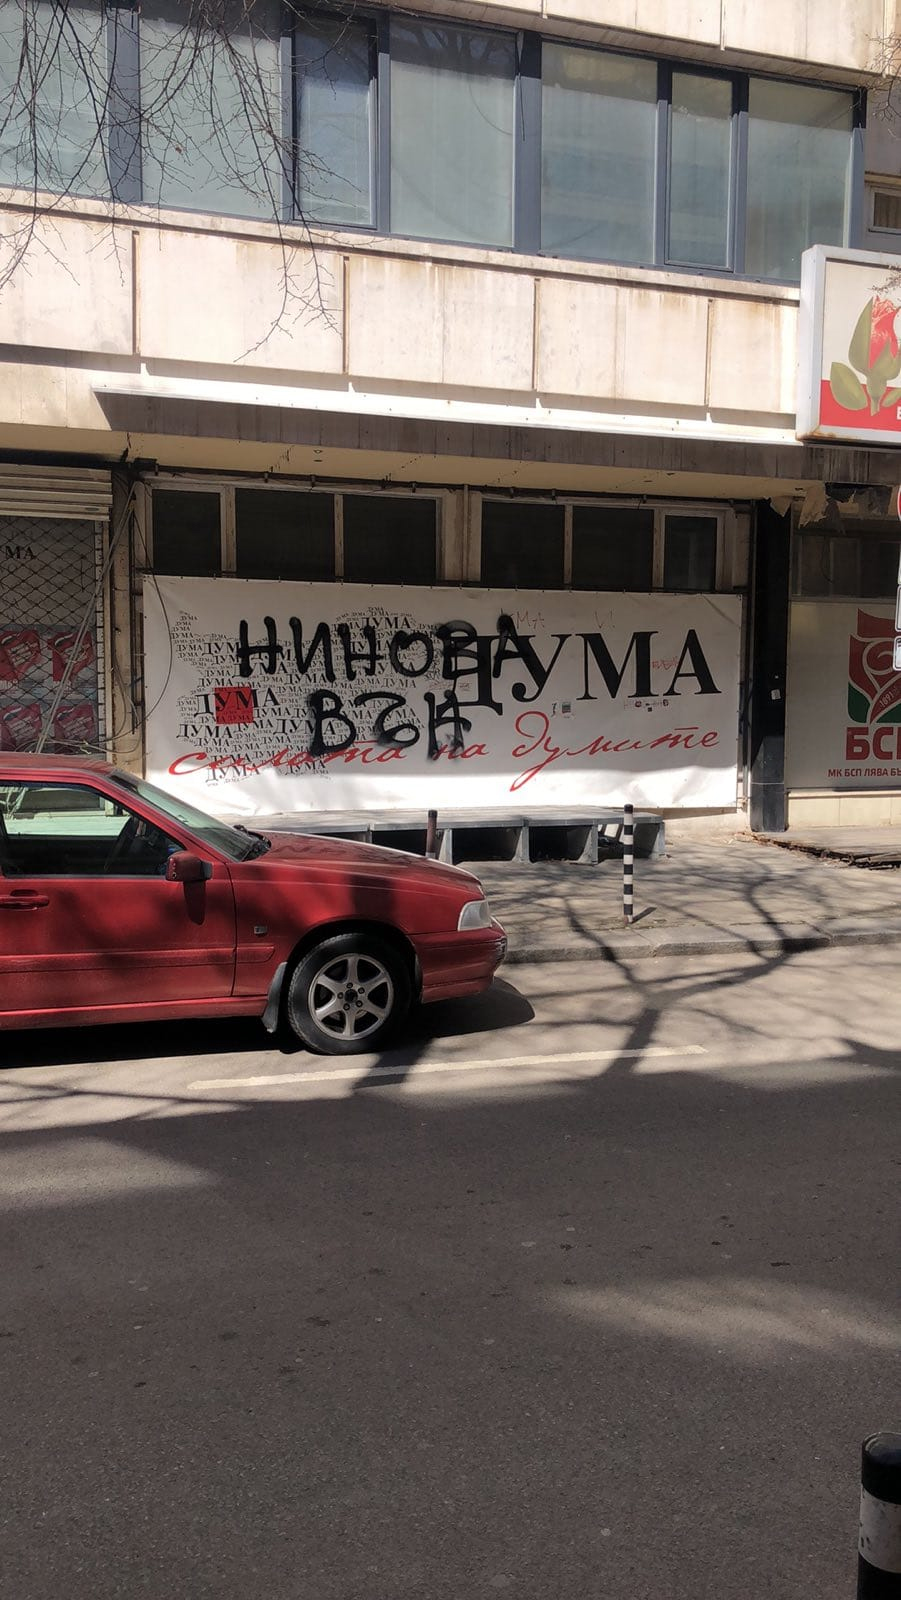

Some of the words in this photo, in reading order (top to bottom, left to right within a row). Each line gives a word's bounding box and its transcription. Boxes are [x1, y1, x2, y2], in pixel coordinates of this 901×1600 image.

[436, 628, 723, 717] ДУМА
[198, 678, 233, 688] ДУМА
[194, 687, 280, 718] ДУМА
[252, 707, 292, 719] ДУМА
[176, 723, 233, 739] ДУМА
[307, 689, 473, 763] ВЪН
[193, 738, 231, 747] ДУМА
[260, 735, 291, 745] ДУМА
[846, 727, 901, 760] БС
[510, 710, 720, 792] думите
[205, 763, 260, 783] ДУМА
[828, 769, 842, 777] МК
[844, 768, 862, 777] БСП
[864, 767, 889, 777] ЛЯВА
